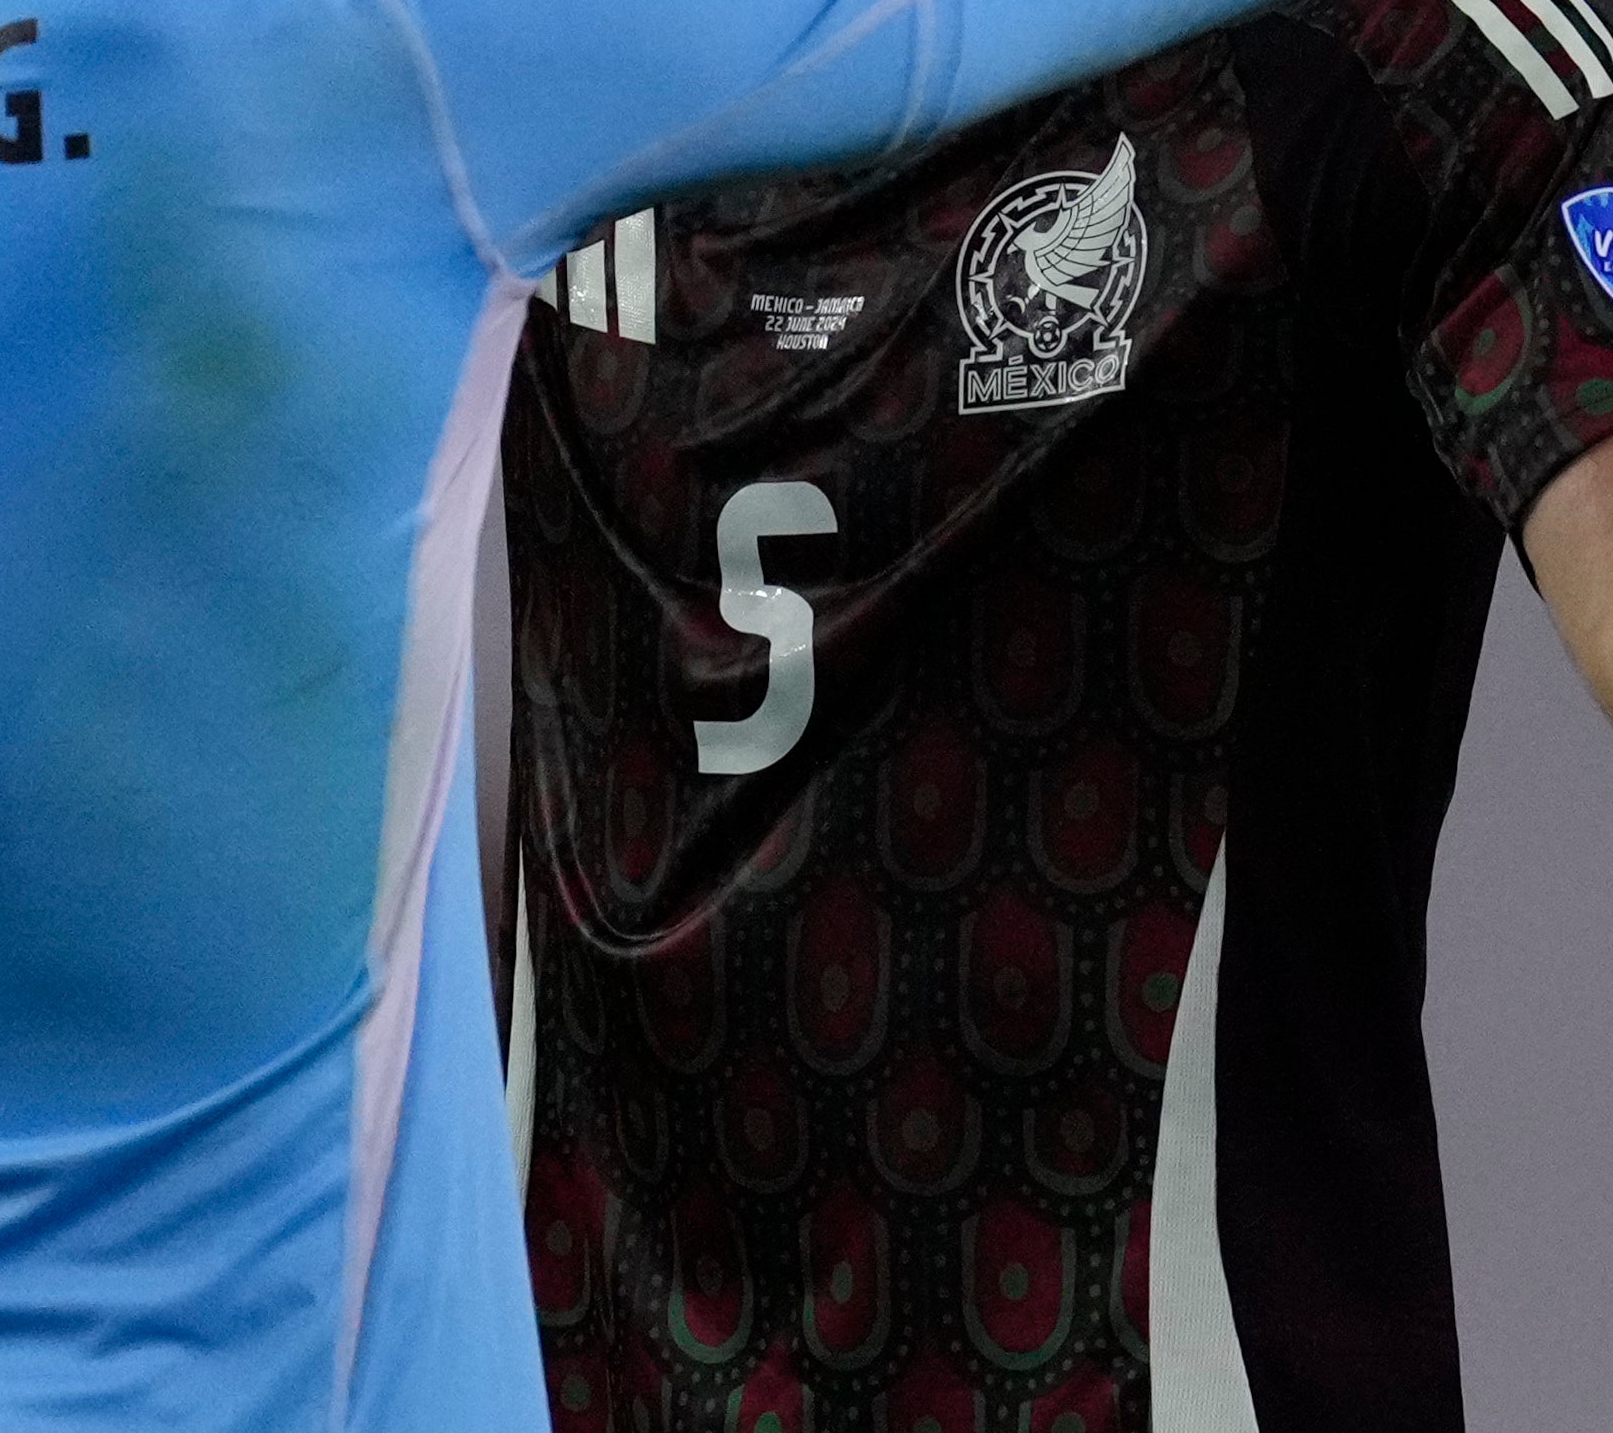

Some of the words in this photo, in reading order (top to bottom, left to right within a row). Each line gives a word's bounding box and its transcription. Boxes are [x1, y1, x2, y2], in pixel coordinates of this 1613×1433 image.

[764, 315, 784, 332] 22
[785, 316, 815, 332] JUNE
[816, 316, 847, 332] 2024
[776, 333, 829, 350] HOUSTON
[967, 353, 1120, 404] MÉXICO
[693, 480, 839, 775] 5
